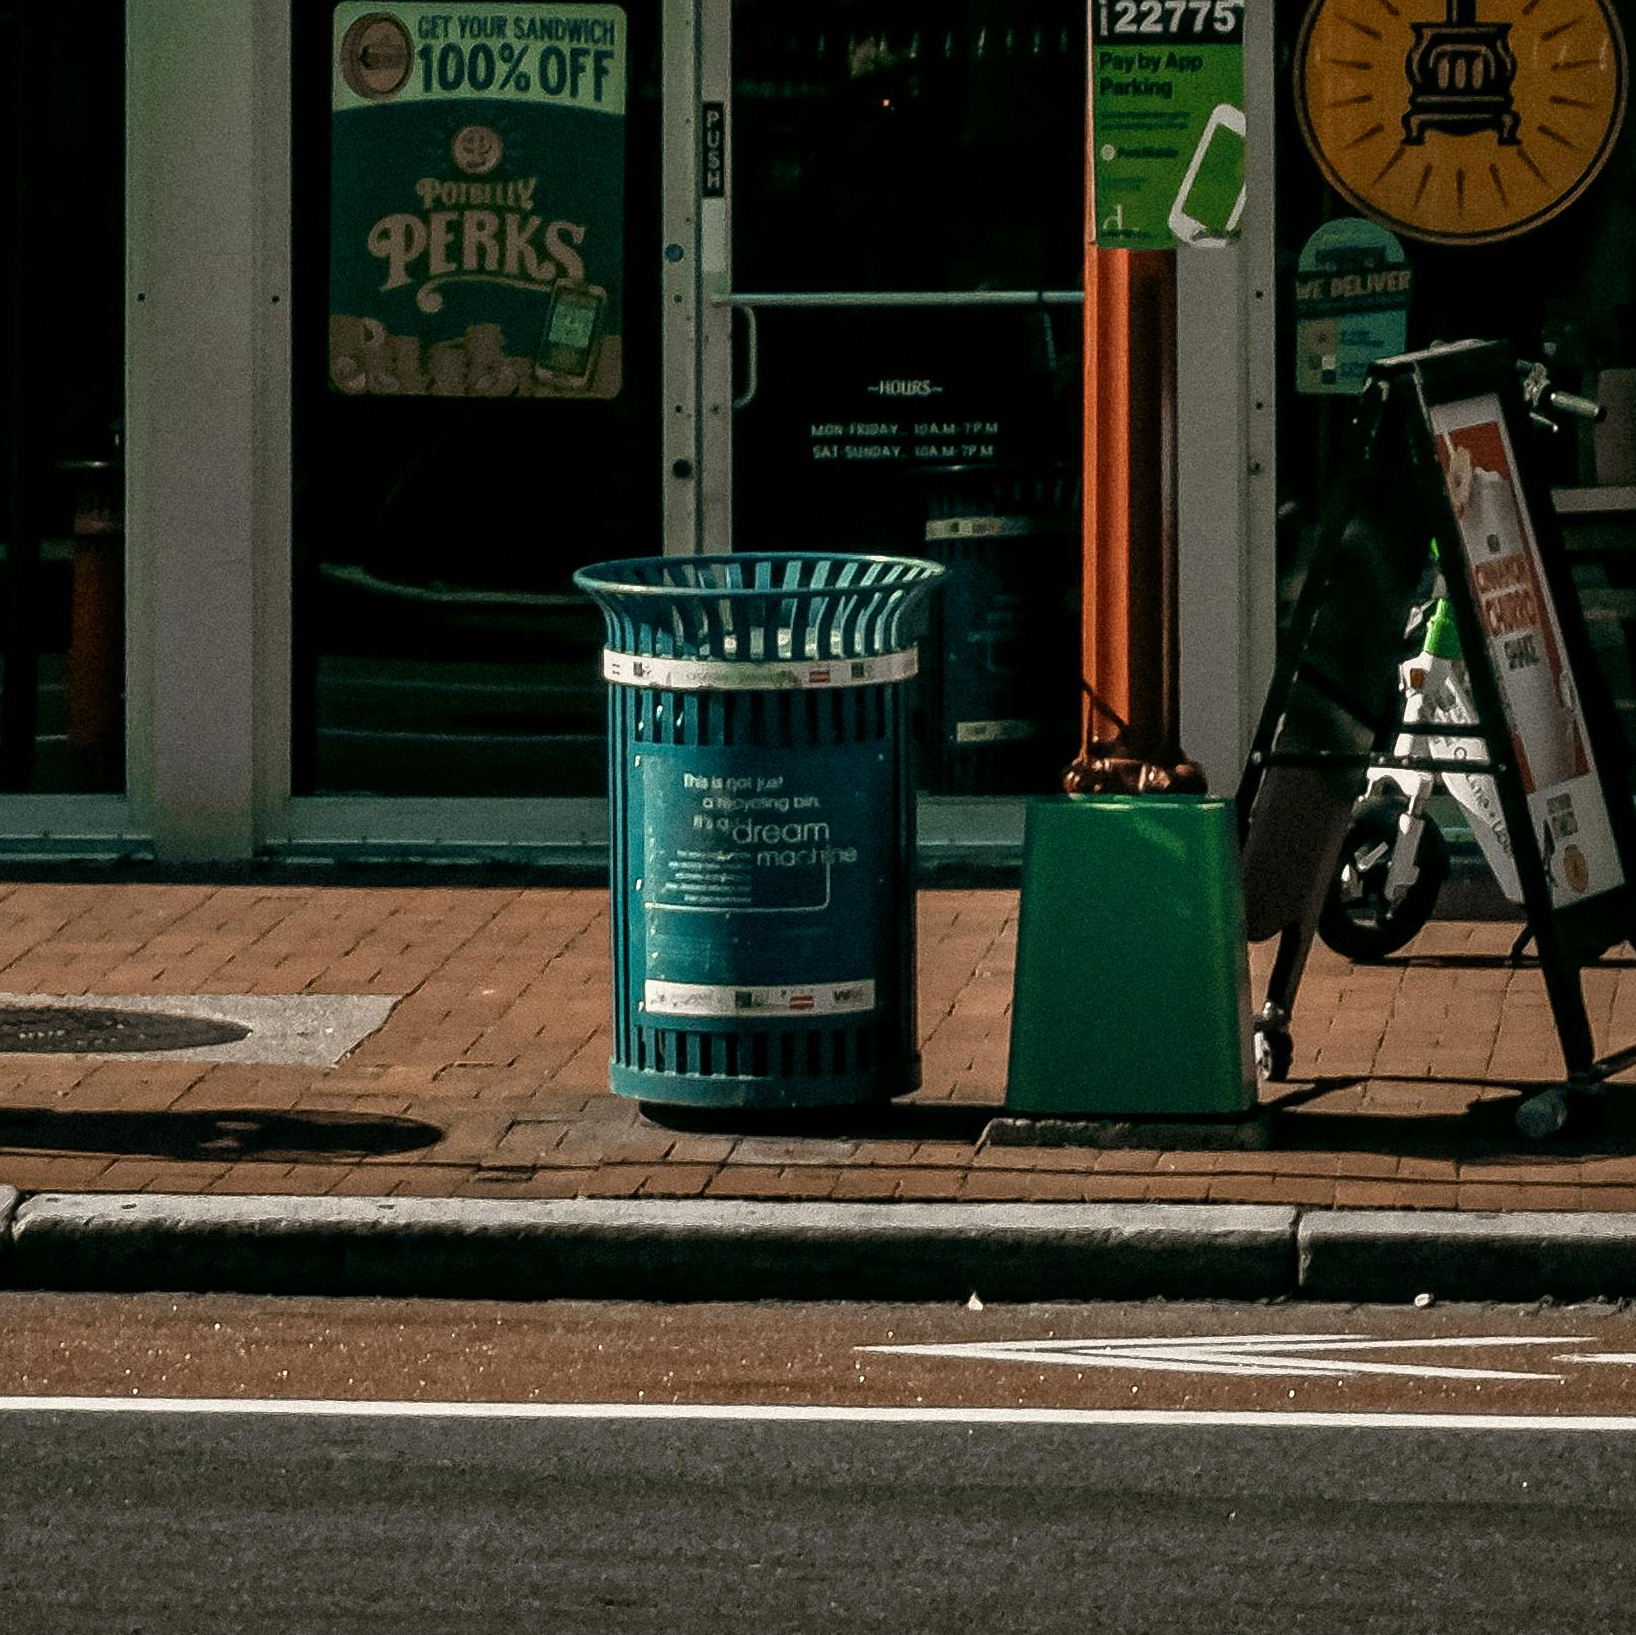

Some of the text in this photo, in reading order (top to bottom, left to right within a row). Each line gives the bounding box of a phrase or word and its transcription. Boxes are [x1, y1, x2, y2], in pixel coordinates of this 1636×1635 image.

[418, 15, 616, 46] GET YOUR SANDWICH
[418, 42, 616, 103] 100% OFF
[1100, 51, 1204, 73] Pay by App
[1100, 76, 1173, 100] Parking
[706, 109, 721, 190] PUSH
[367, 209, 587, 292] PERKS
[702, 797, 714, 809] a
[731, 816, 830, 844] dream
[756, 846, 858, 867] machine
